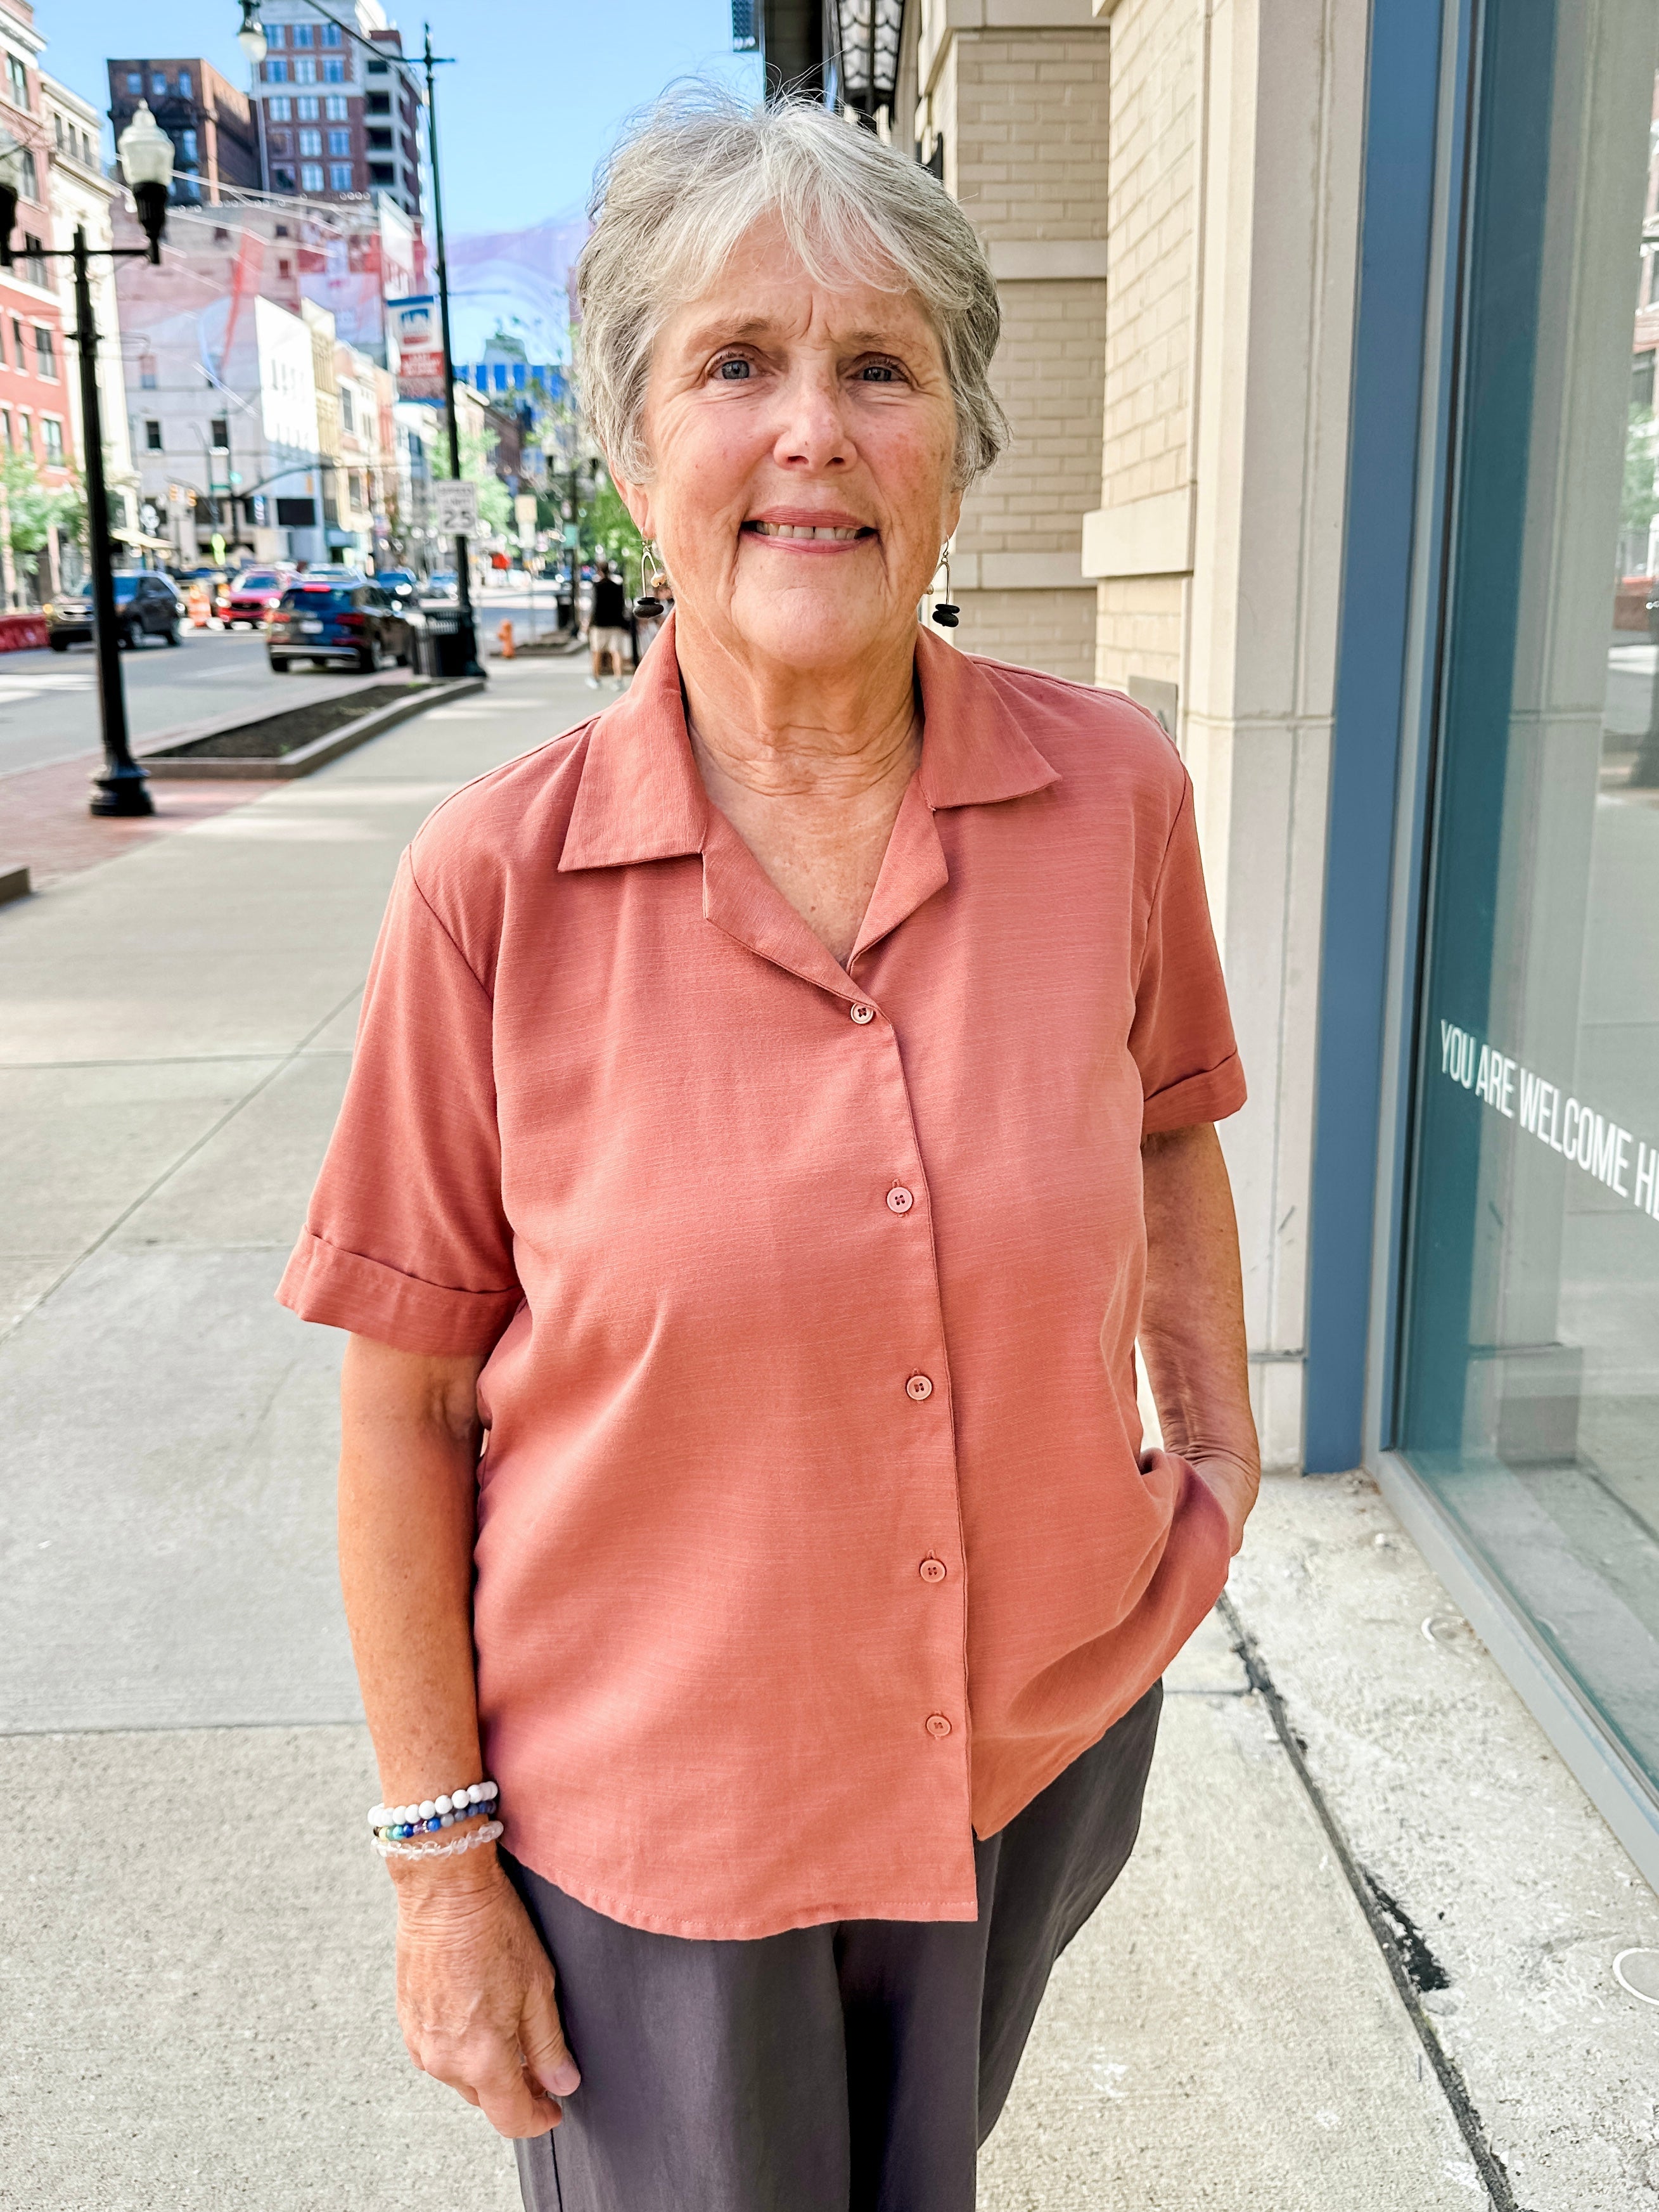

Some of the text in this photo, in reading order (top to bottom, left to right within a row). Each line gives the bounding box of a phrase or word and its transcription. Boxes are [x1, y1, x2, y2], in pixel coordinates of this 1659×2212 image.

[444, 510, 475, 529] 25
[1440, 1019, 1476, 1090] YOU
[1475, 1044, 1518, 1119] ARE
[1520, 1067, 1633, 1199] WELCOME
